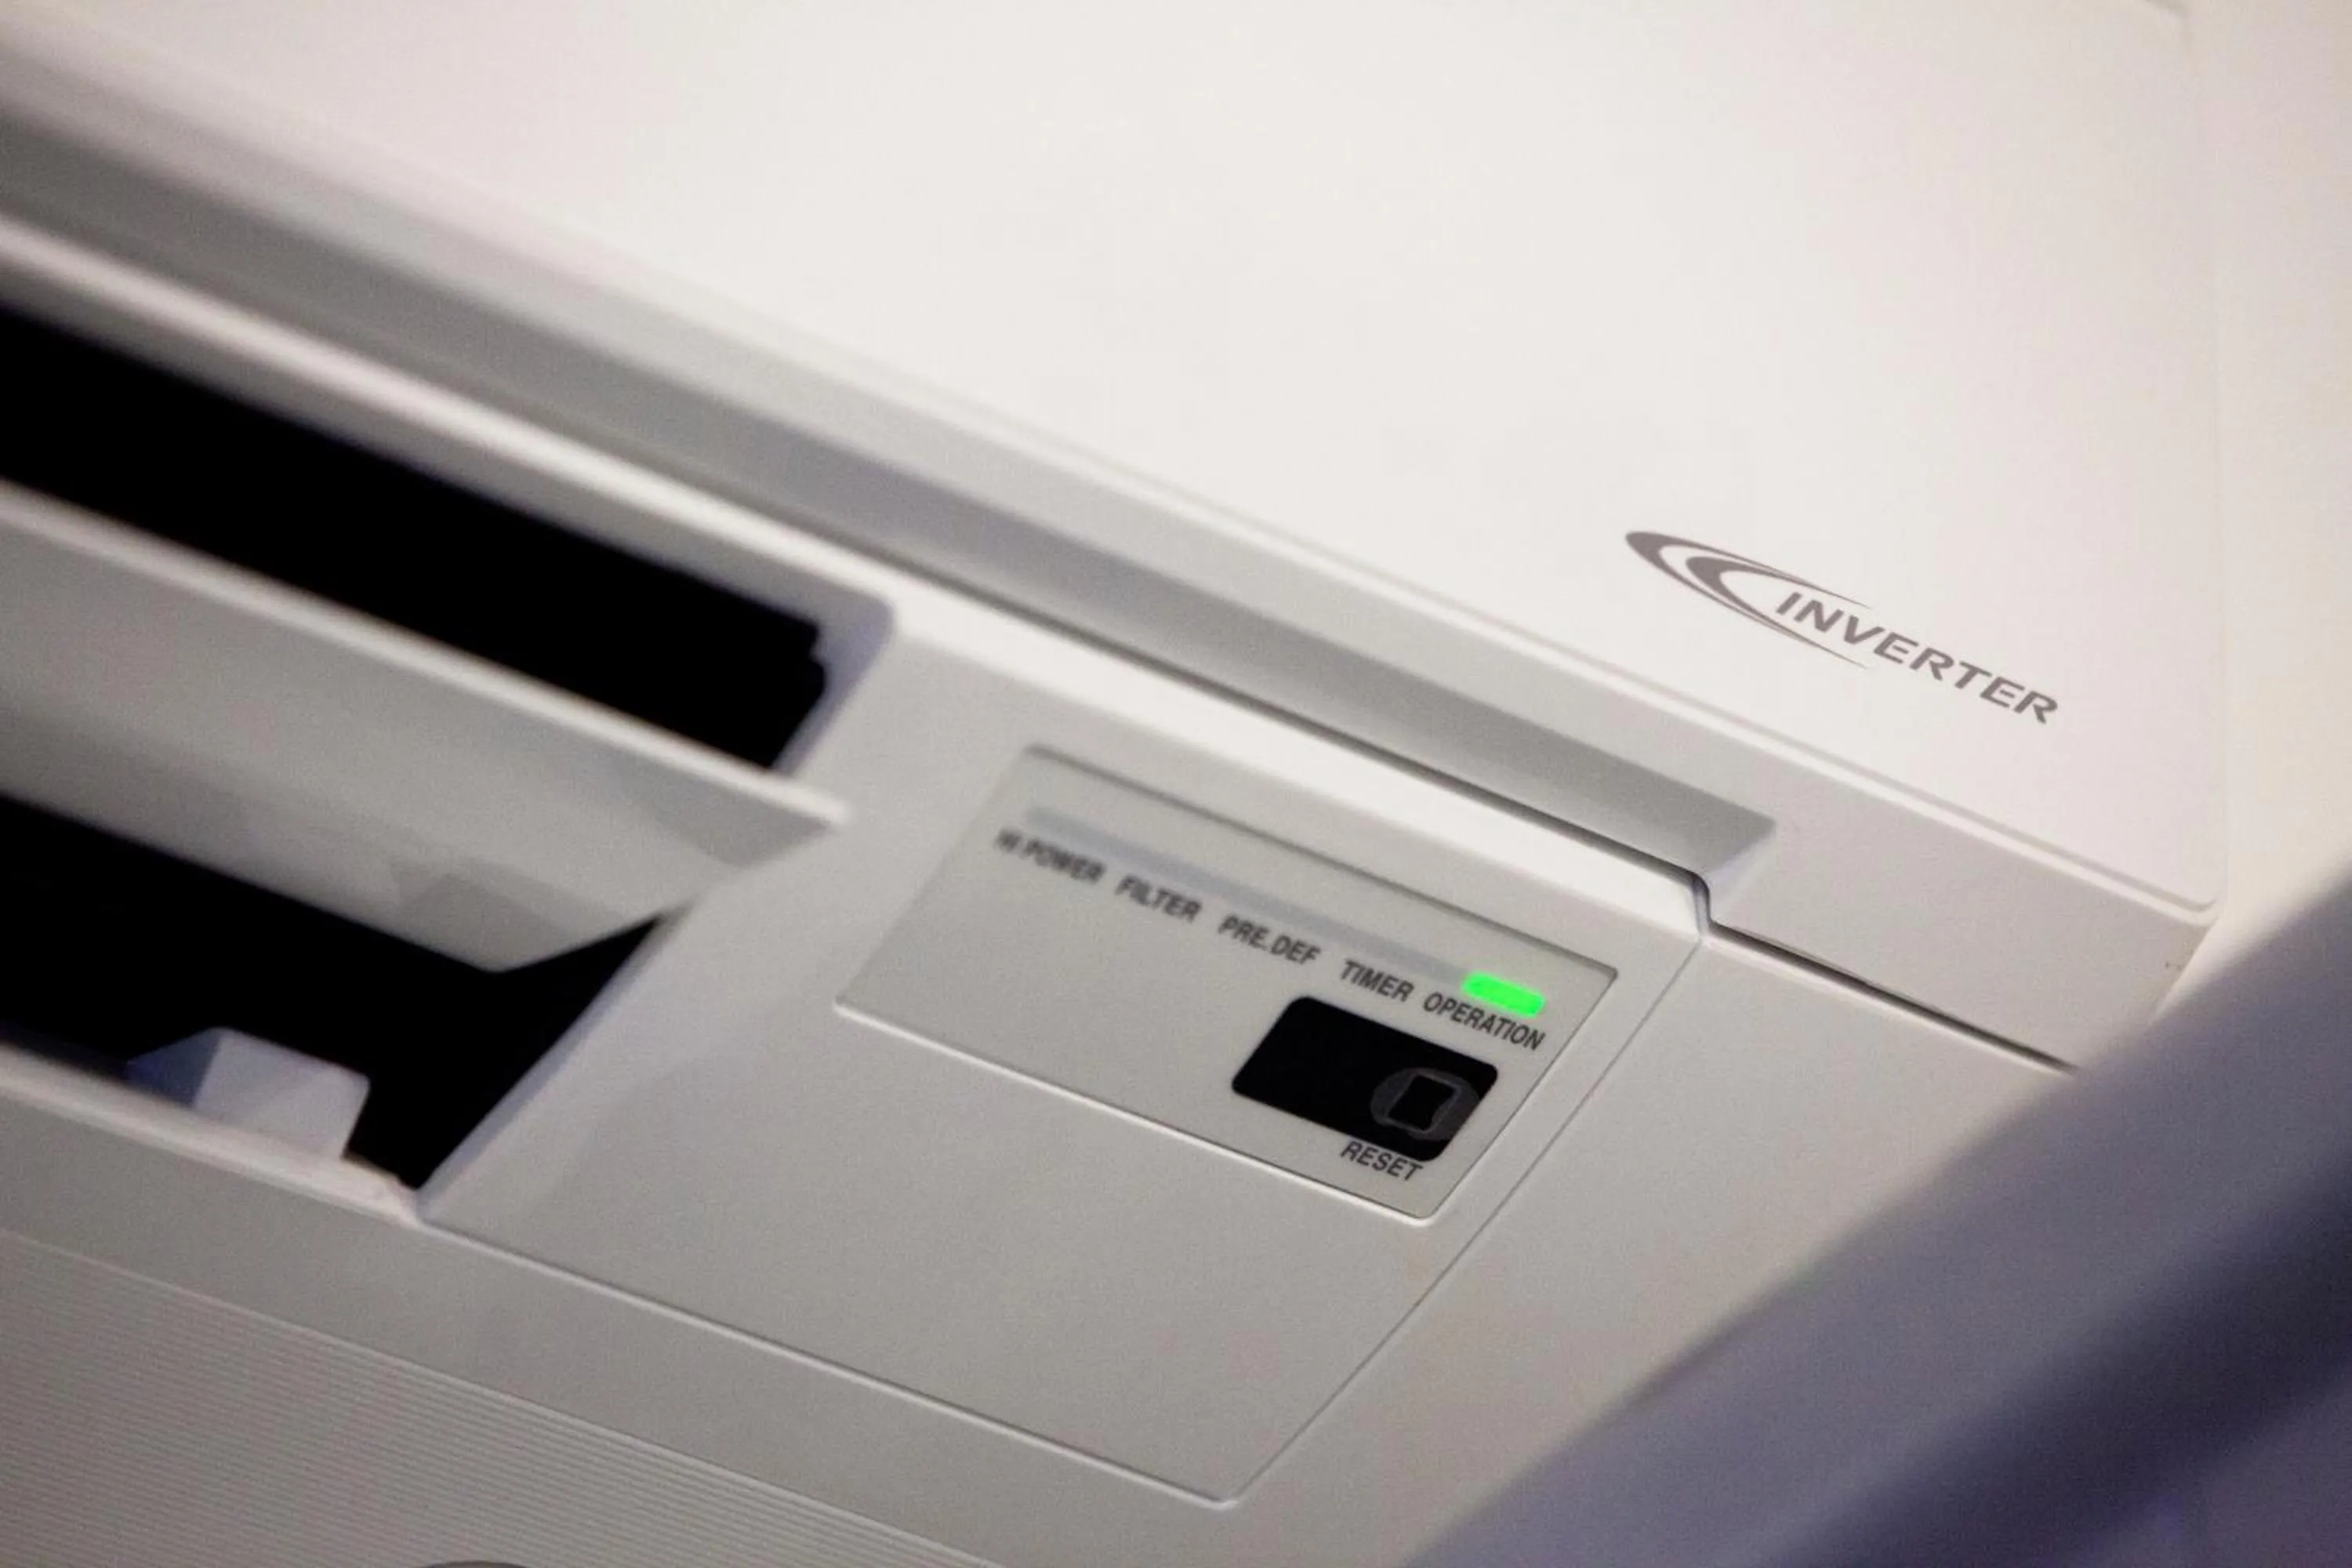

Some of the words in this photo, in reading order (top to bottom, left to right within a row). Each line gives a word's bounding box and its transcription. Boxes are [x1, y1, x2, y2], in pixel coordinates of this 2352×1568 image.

[1776, 592, 2058, 724] INVERTER
[1022, 838, 1105, 884] POWER
[1115, 875, 1202, 923] FILTER
[1218, 915, 1320, 965] PRE.DEF
[1341, 960, 1414, 1003] TIMER
[1423, 991, 1545, 1051] OPERATION
[1341, 1141, 1423, 1181] RESET
